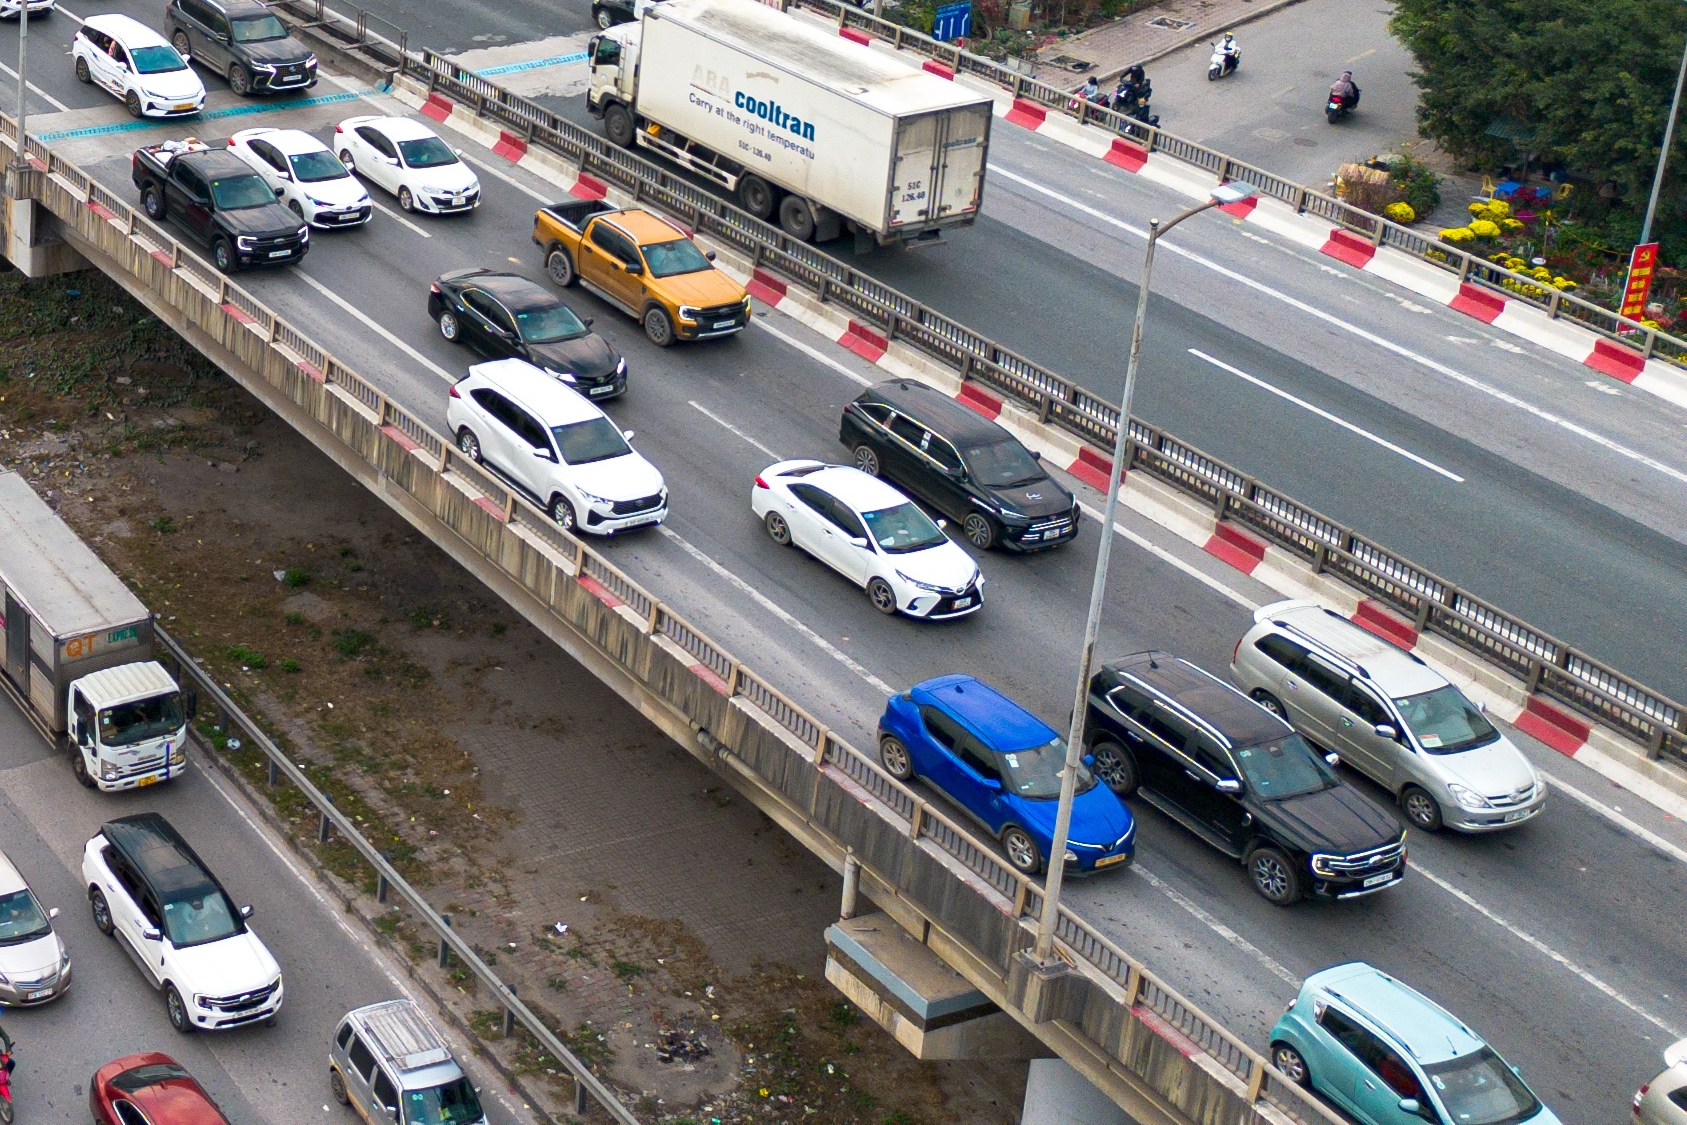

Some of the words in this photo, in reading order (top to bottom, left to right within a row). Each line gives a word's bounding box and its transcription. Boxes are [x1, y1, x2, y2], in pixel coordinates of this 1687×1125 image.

[689, 92, 714, 114] Carry
[715, 106, 724, 118] at
[727, 110, 741, 125] the
[742, 119, 765, 136] right
[767, 129, 815, 160] temperatu
[734, 90, 815, 143] cooltran
[65, 633, 100, 659] QT
